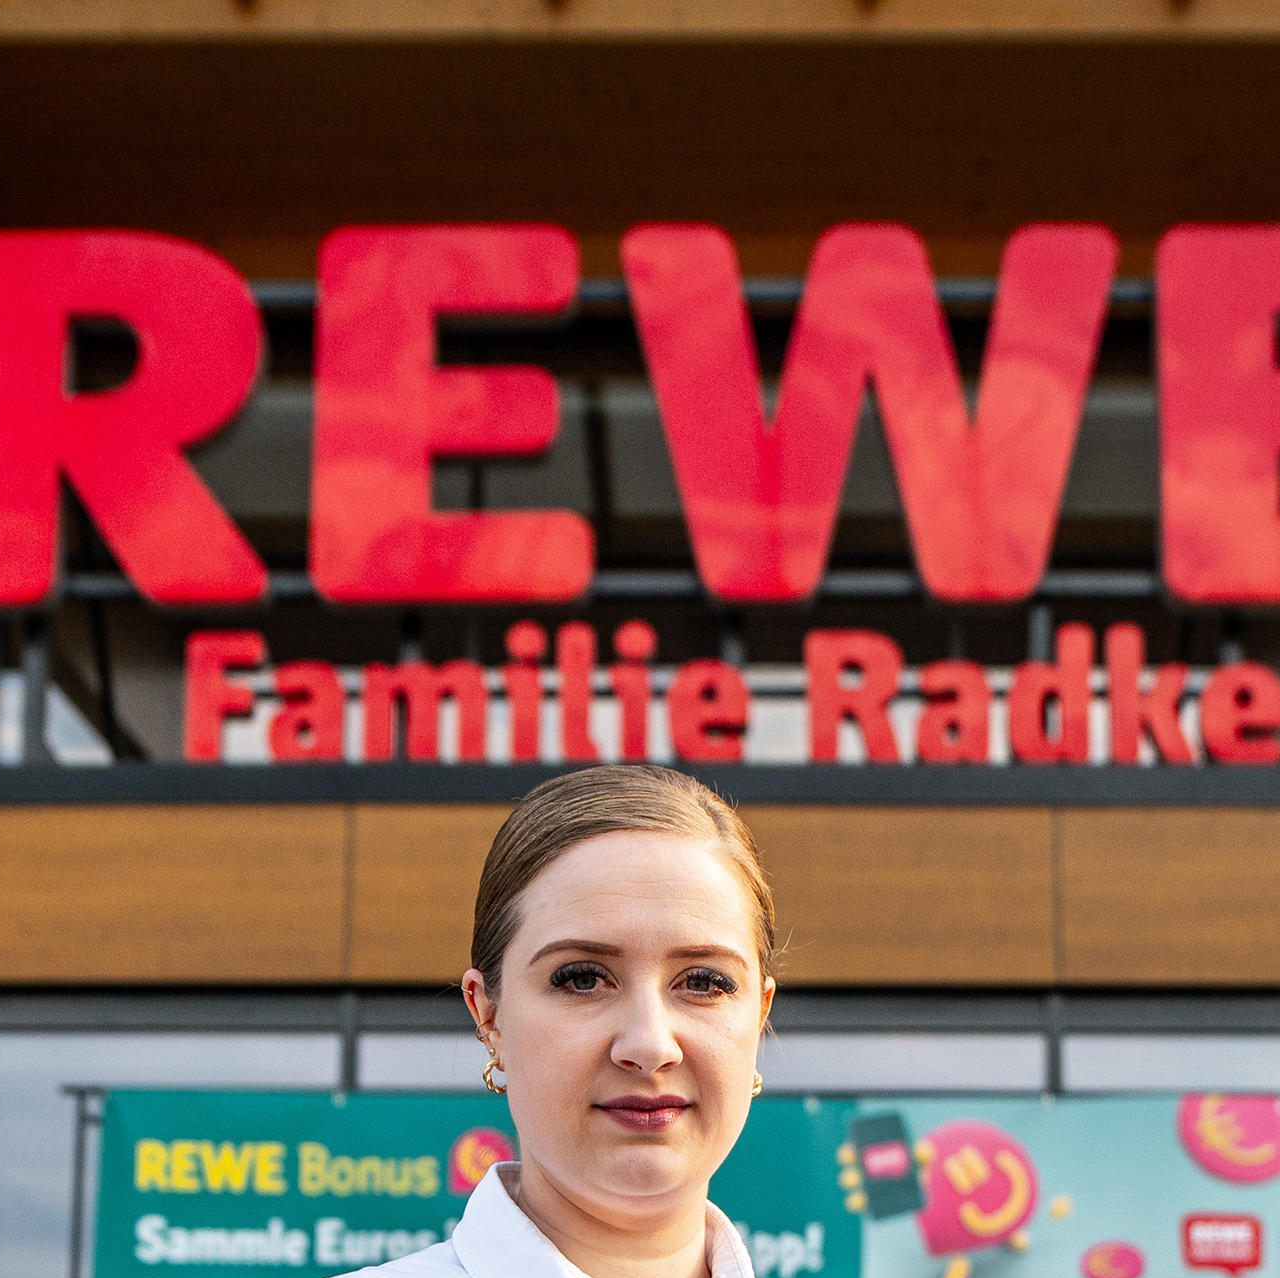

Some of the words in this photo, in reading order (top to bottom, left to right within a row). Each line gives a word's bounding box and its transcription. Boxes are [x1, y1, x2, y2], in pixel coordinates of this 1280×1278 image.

[182, 620, 754, 763] Familie
[135, 1139, 287, 1194] REWE
[298, 1142, 439, 1195] Bonus
[134, 1213, 311, 1265] Sammle
